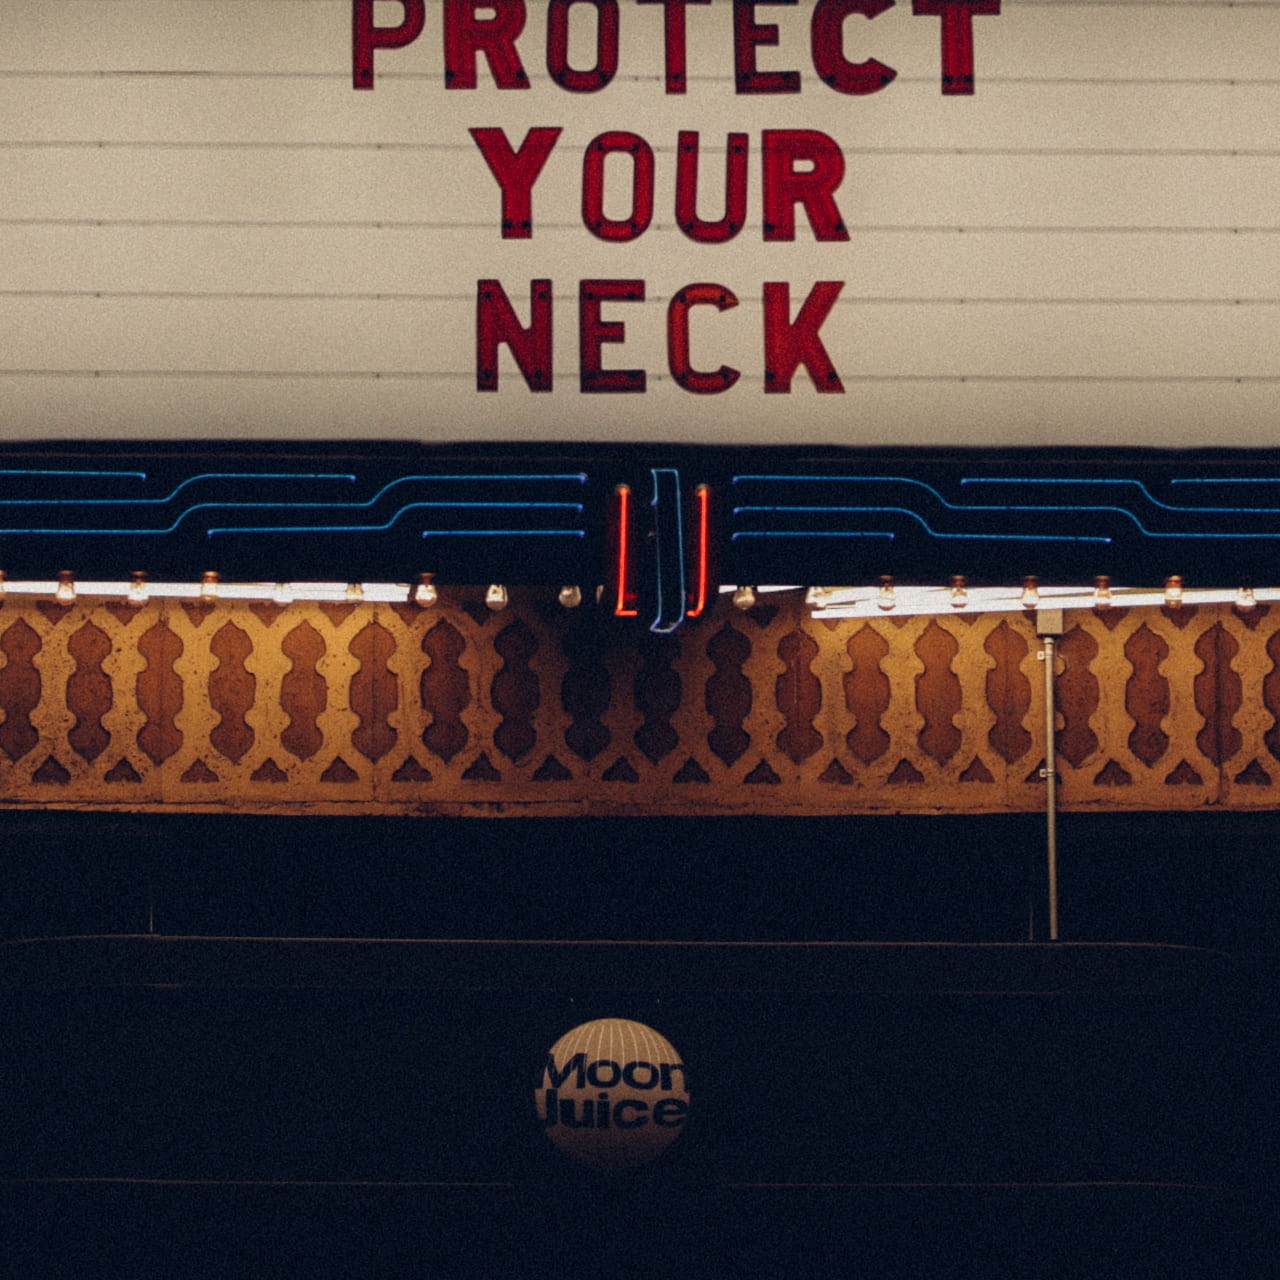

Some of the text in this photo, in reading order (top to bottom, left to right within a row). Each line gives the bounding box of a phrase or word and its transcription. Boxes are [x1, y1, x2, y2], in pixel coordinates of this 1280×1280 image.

[467, 126, 852, 244] YOUR
[475, 278, 847, 396] NECK
[535, 1052, 689, 1093] Moon
